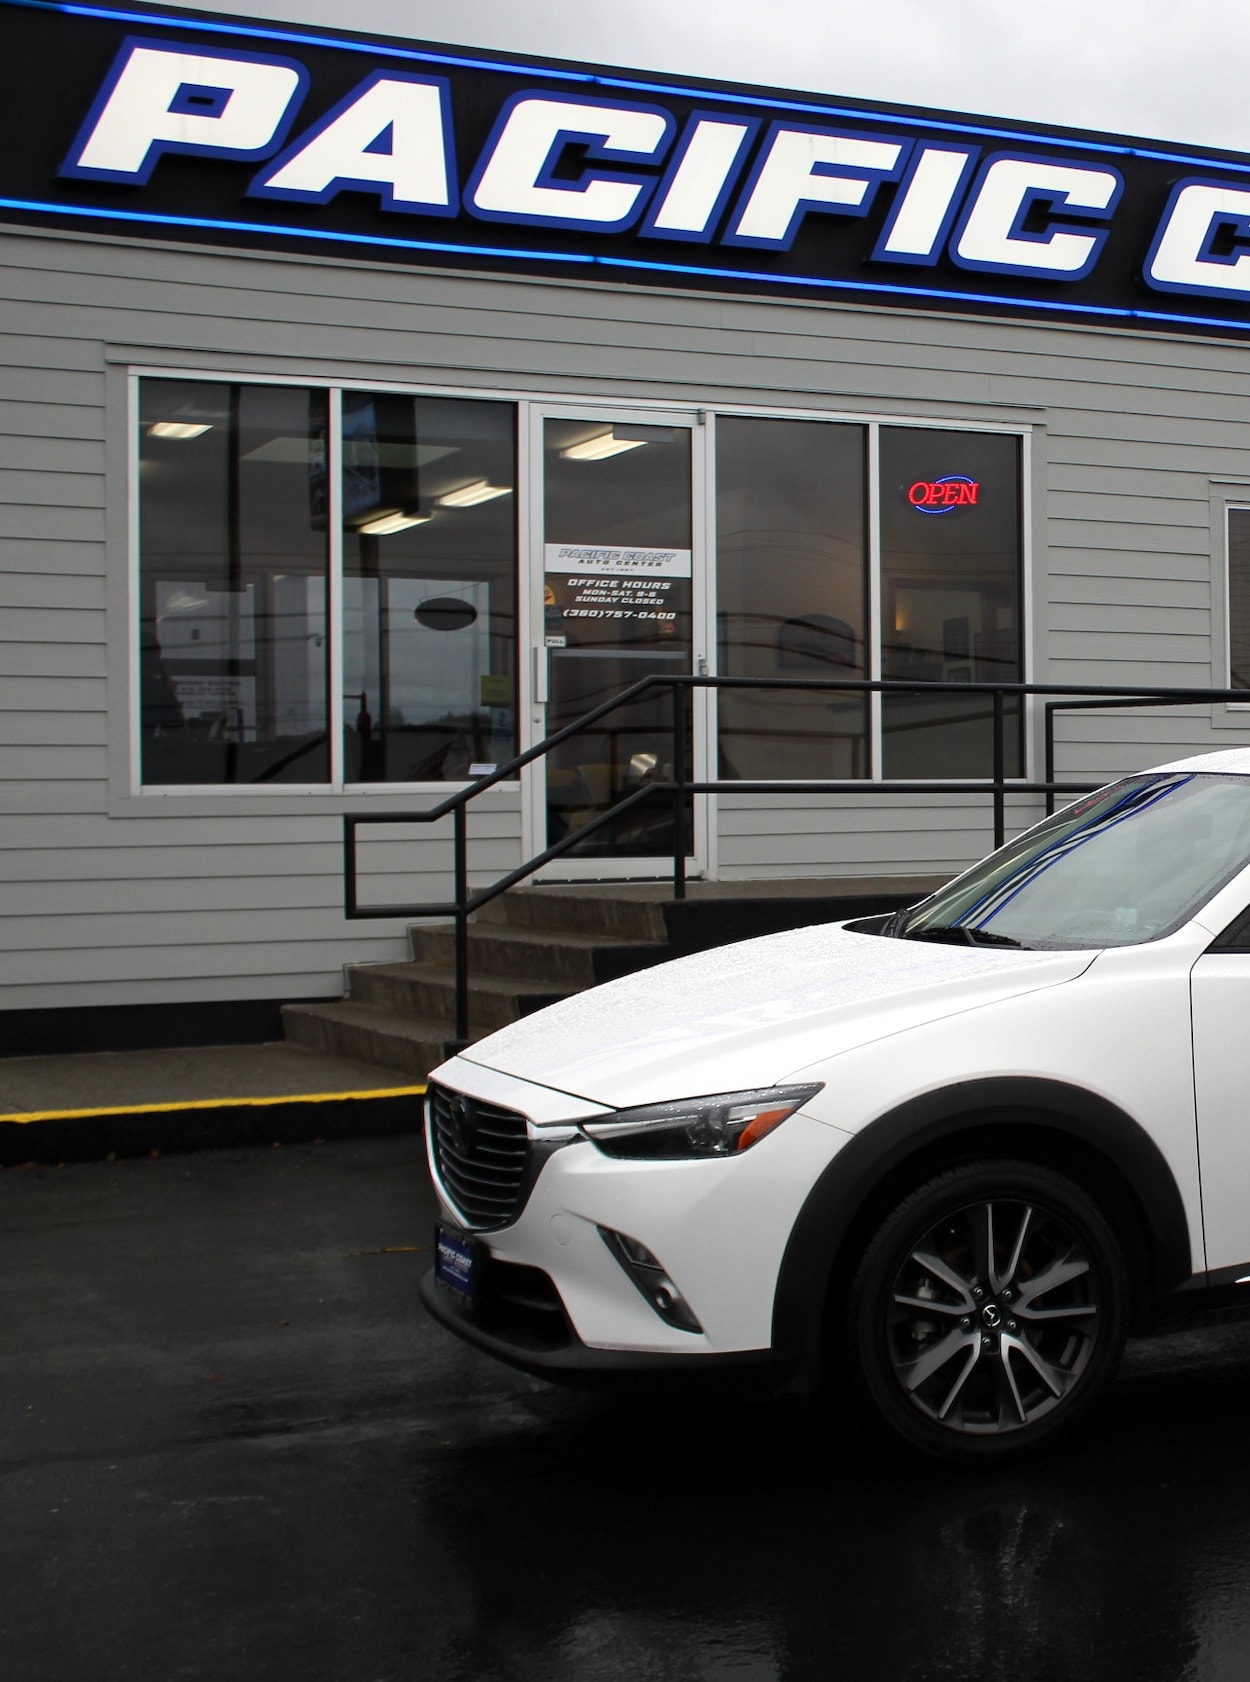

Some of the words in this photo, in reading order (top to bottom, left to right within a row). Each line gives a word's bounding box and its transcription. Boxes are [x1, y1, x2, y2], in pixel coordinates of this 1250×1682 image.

[60, 37, 1124, 279] PACIFIC
[908, 481, 979, 505] OPEN
[558, 548, 621, 560] PACIFIC
[622, 551, 676, 562] COAST
[616, 560, 663, 568] CENTER
[567, 578, 620, 588] OFFICE
[622, 580, 672, 590] HOURS
[620, 597, 665, 605] CLOSED
